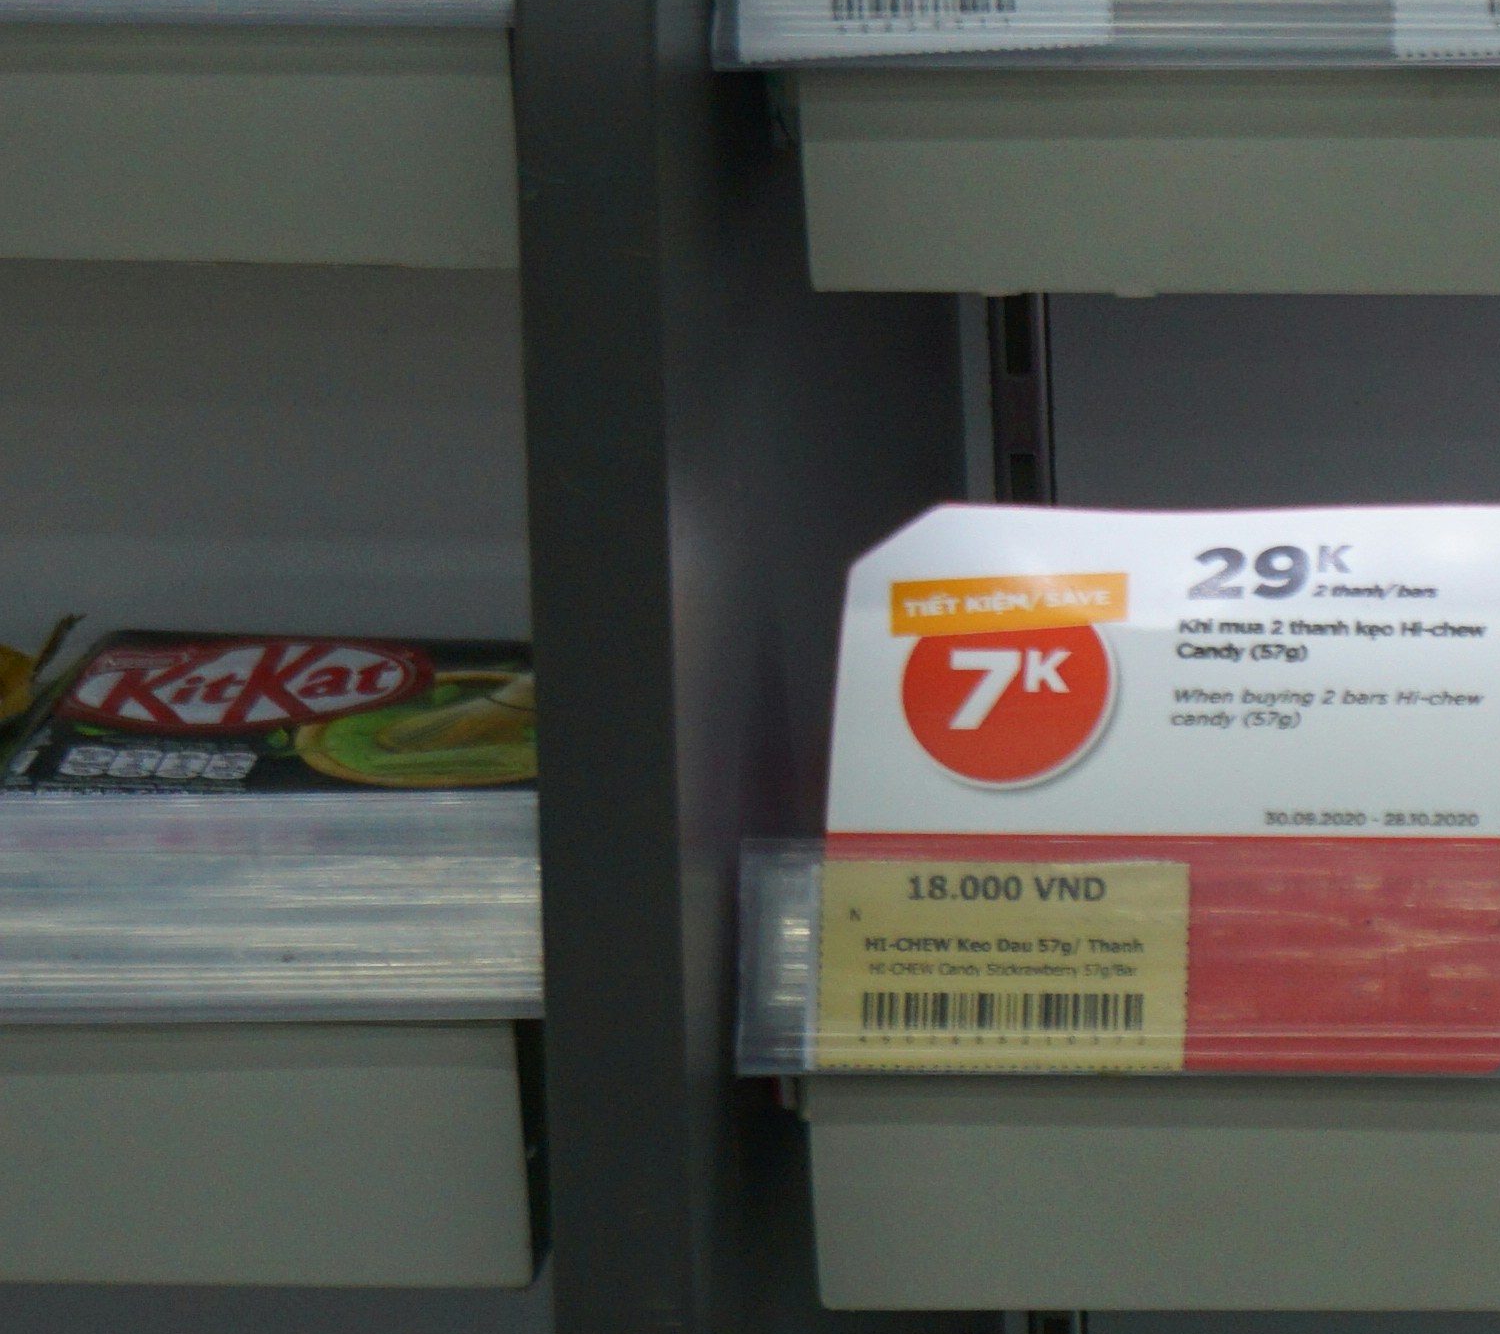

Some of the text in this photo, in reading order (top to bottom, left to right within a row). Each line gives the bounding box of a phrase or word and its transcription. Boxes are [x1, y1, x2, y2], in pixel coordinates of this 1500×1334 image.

[96, 644, 402, 726] KitKat
[908, 876, 1106, 902] 18.000 VND
